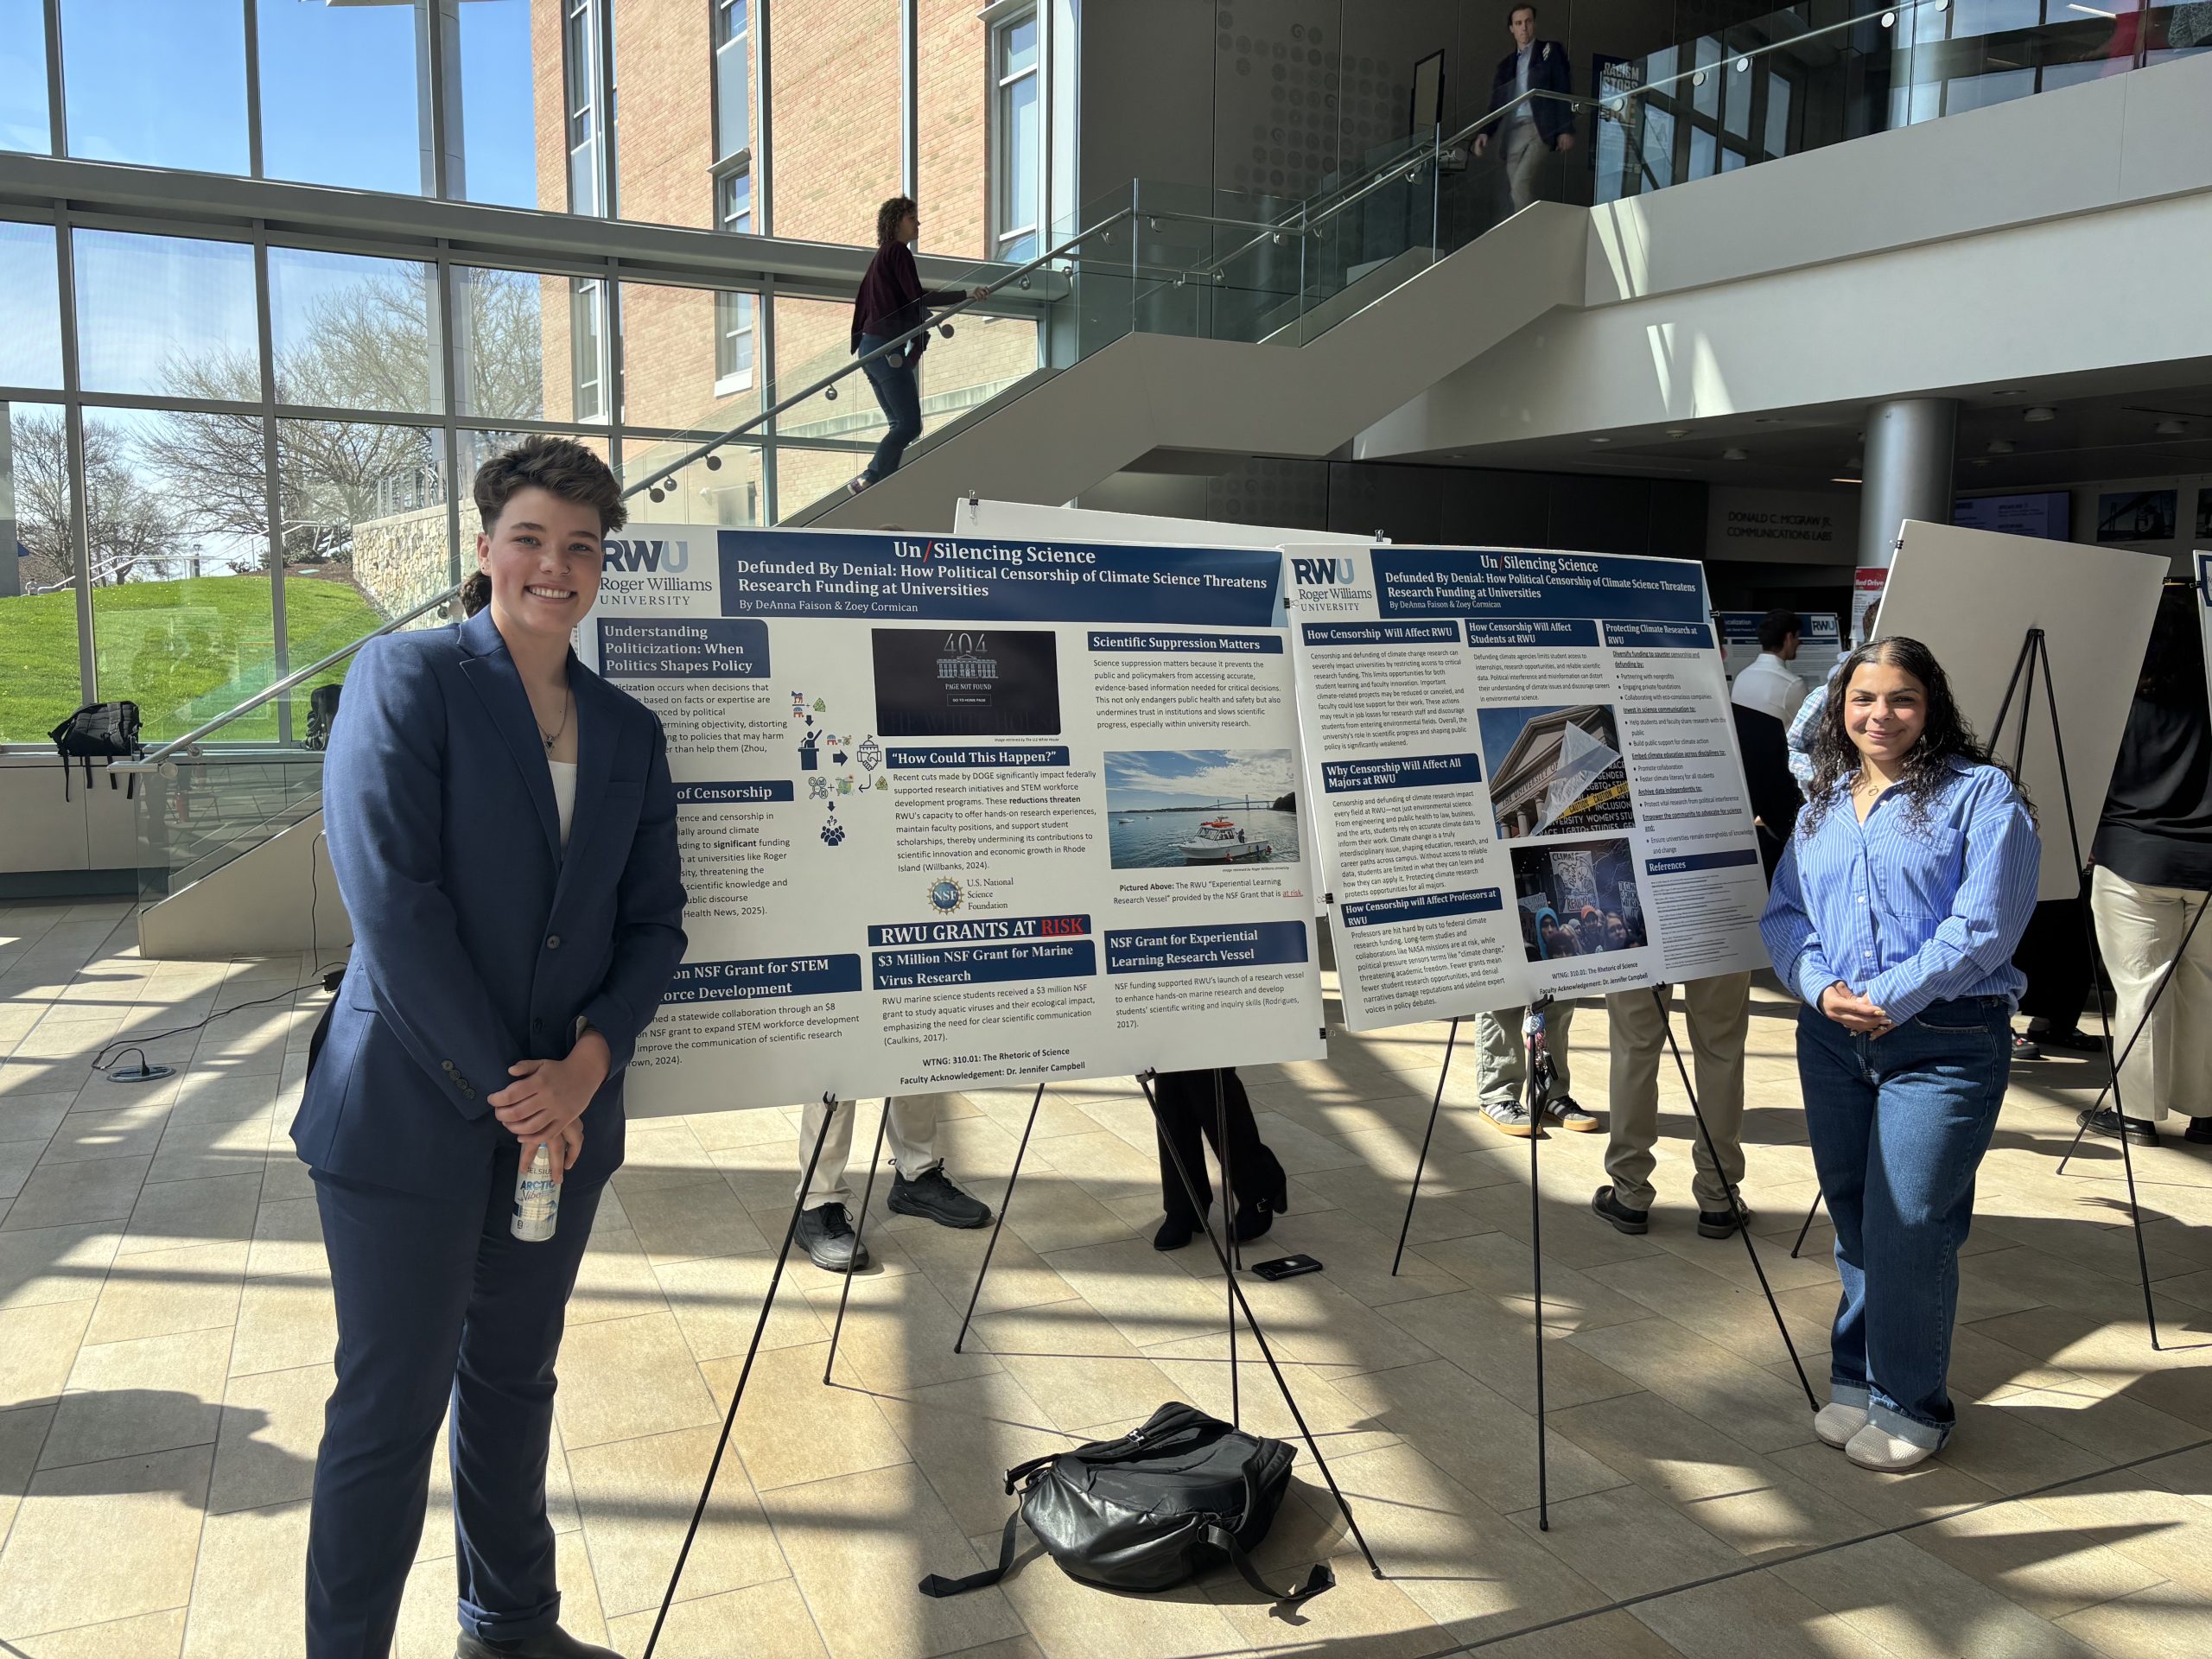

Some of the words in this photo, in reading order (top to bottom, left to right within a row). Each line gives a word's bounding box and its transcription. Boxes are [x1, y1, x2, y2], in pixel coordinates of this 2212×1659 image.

[1604, 62, 1639, 80] RACISM
[1728, 512, 1768, 524] DONALD
[1726, 526, 1811, 540] COMMUNICATIONS
[1812, 531, 1833, 541] LABS
[602, 540, 689, 573] RWU
[1027, 546, 1096, 564] Science
[1291, 558, 1355, 585] RWU
[1558, 557, 1599, 573] Science
[737, 560, 815, 574] Defunded
[819, 562, 838, 578] By
[842, 563, 896, 576] Denial:
[900, 564, 933, 577] How
[938, 565, 997, 579] Political
[1001, 567, 1078, 584] Censorship
[1082, 569, 1096, 582] of
[1099, 570, 1149, 583] Climate
[1153, 572, 1200, 586] Science
[1203, 574, 1267, 588] Threatens
[600, 577, 645, 594] Roger
[646, 577, 712, 591] Williams
[738, 578, 810, 592] Research
[815, 580, 879, 596] Funding
[881, 582, 897, 594] at
[900, 582, 988, 596] Universities
[600, 594, 690, 605] UNIVERSITY
[1298, 588, 1328, 602] Roger
[1329, 588, 1372, 599] Williams
[739, 599, 753, 611] By
[755, 600, 796, 609] DeAnna
[798, 600, 831, 609] Faison
[834, 601, 842, 610] &
[844, 601, 868, 613] Zoey
[871, 601, 918, 612] Cormican
[1300, 602, 1358, 612] UNIVERSITY
[604, 625, 708, 639] Understanding
[1468, 622, 1487, 631] How
[1488, 622, 1532, 633] Censorship
[1532, 622, 1549, 631] Will
[1550, 622, 1572, 631] Affect
[1812, 620, 1835, 632] RWU
[1306, 629, 1328, 639] How
[1330, 628, 1381, 640] Censorship
[1383, 627, 1403, 638] Will
[1404, 627, 1430, 637] Affect
[1431, 627, 1452, 636] RWU
[1471, 633, 1506, 644] Students
[1516, 634, 1535, 643] RWU
[605, 642, 701, 653] Politicization:
[703, 643, 743, 654] When
[944, 632, 988, 654] 404
[1093, 636, 1147, 647] Scientific
[1148, 637, 1217, 650] Suppression
[1218, 639, 1260, 649] Matters
[606, 659, 657, 671] Politics
[660, 659, 709, 674] Shapes
[712, 659, 753, 673] Policy
[1121, 659, 1161, 668] suppression
[929, 752, 965, 763] Could
[968, 751, 995, 762] This
[1325, 766, 1348, 777] Why
[1350, 762, 1400, 774] Censorship
[1401, 760, 1421, 771] Will
[1422, 759, 1447, 769] Affect
[1449, 757, 1461, 767] All
[961, 772, 970, 781] by
[995, 771, 1039, 780] significantly
[1039, 771, 1065, 779] impact
[1065, 770, 1096, 779] federally
[1328, 777, 1361, 789] Majors
[1362, 776, 1372, 785] at
[1373, 773, 1395, 784] RWU
[677, 787, 691, 798] of
[694, 786, 772, 800] Censorship
[1649, 861, 1688, 872] References
[966, 878, 982, 887] U.S.
[983, 877, 1014, 887] National
[933, 889, 958, 901] NSF
[967, 890, 993, 899] Science
[683, 910, 711, 918] Health
[714, 908, 740, 918] News,
[741, 906, 767, 915] 2025).
[968, 901, 1007, 910] Foundation
[880, 925, 927, 944] RWU
[932, 921, 1008, 940] GRANTS
[1013, 919, 1036, 936] AT
[1041, 918, 1084, 935] RISK
[1109, 937, 1132, 948] NSF
[1135, 935, 1167, 946] Grant
[1170, 933, 1187, 944] for
[1189, 929, 1258, 945] Experiential
[878, 955, 893, 967] $3
[897, 953, 940, 965] Million
[944, 950, 969, 963] NSF
[972, 949, 1007, 960] Grant
[1011, 948, 1028, 958] for
[1032, 945, 1073, 957] Marine
[1111, 954, 1164, 967] Learning
[1166, 950, 1217, 963] Research
[1219, 948, 1254, 960] Vessel
[694, 965, 721, 978] NSF
[724, 963, 764, 976] Grant
[767, 962, 788, 973] for
[791, 958, 829, 972] STEM
[879, 975, 912, 986] Virus
[916, 970, 971, 983] Research
[698, 982, 793, 999] Development
[922, 1057, 950, 1066] WTNG:
[952, 1054, 981, 1064] 310.01:
[999, 1050, 1031, 1059] Rhetoric
[899, 1075, 928, 1084] Faculty
[930, 1069, 1004, 1082] Acknowledgement:
[1019, 1065, 1049, 1074] Jennifer
[1050, 1061, 1085, 1071] Campbell
[520, 1179, 555, 1190] ARCTIC
